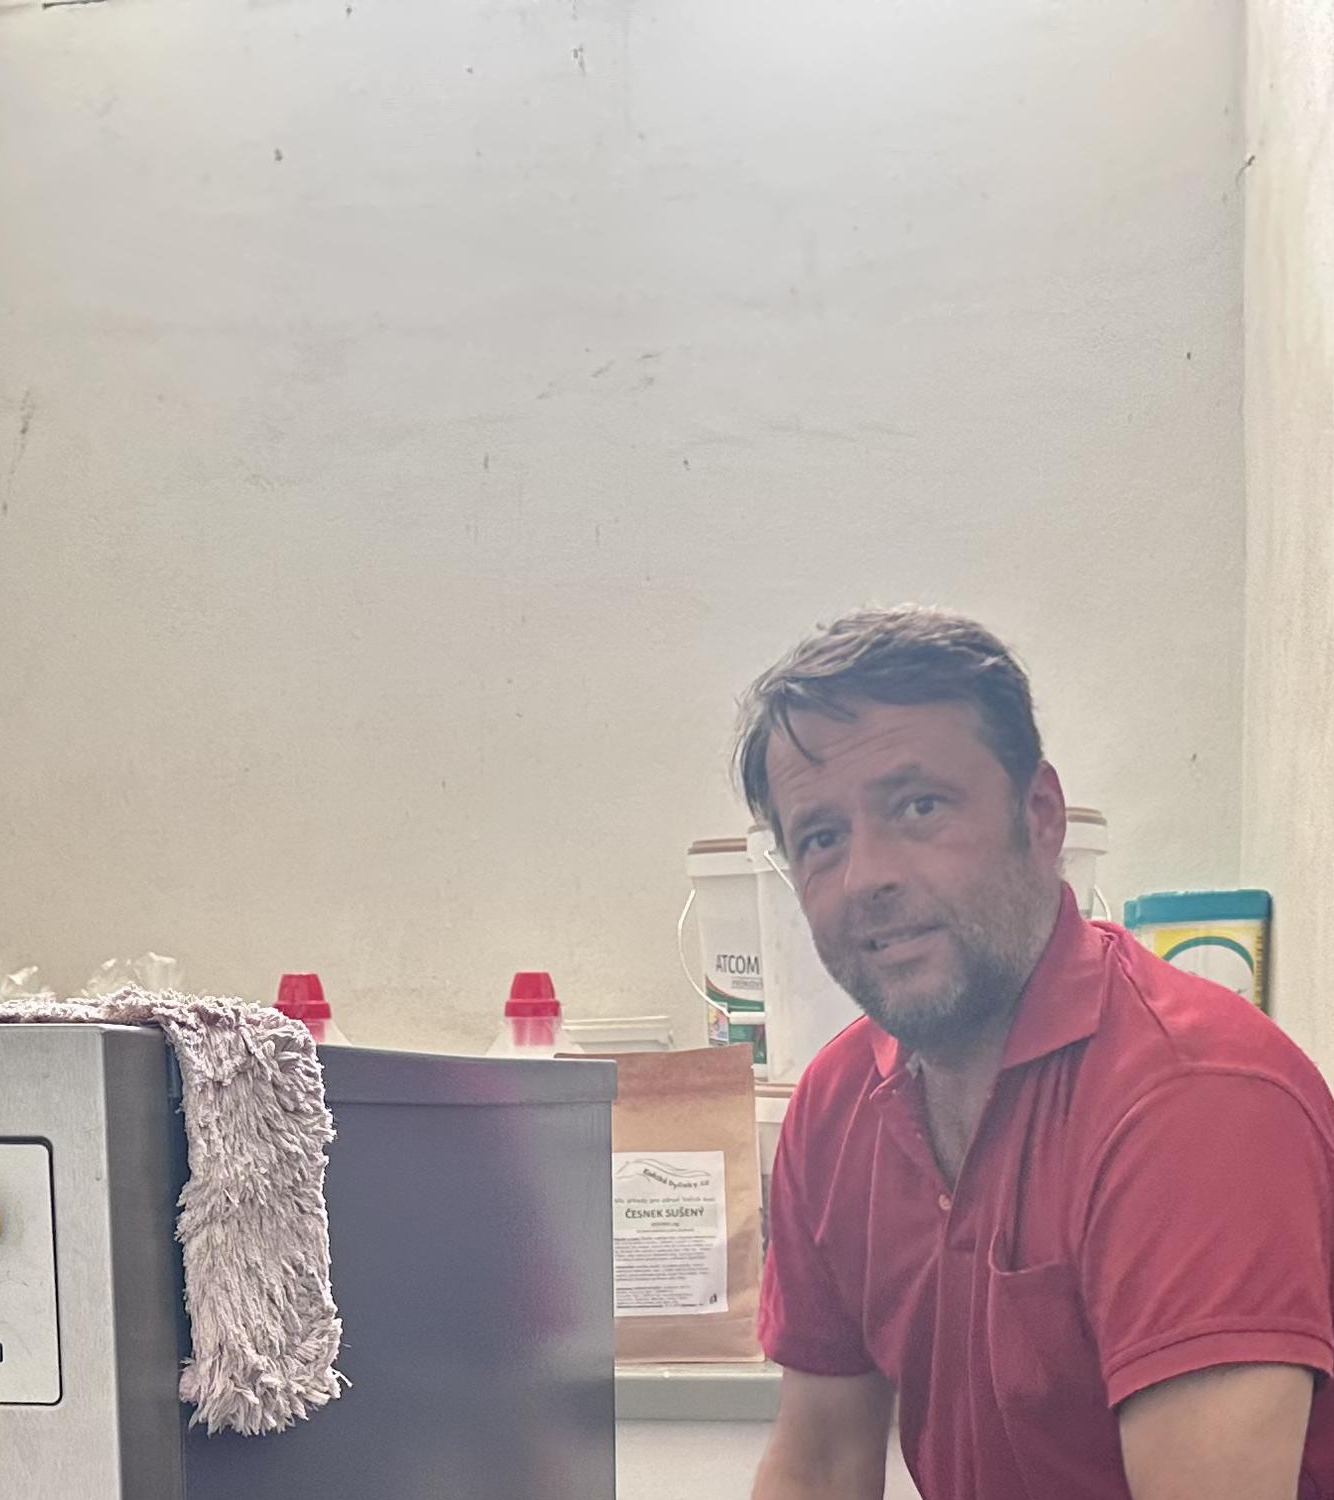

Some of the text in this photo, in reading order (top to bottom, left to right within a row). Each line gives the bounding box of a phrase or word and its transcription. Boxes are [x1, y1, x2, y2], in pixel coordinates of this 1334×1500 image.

[715, 954, 761, 976] ATCOM
[625, 1205, 705, 1219] ČESNEK SUŠENÝ
